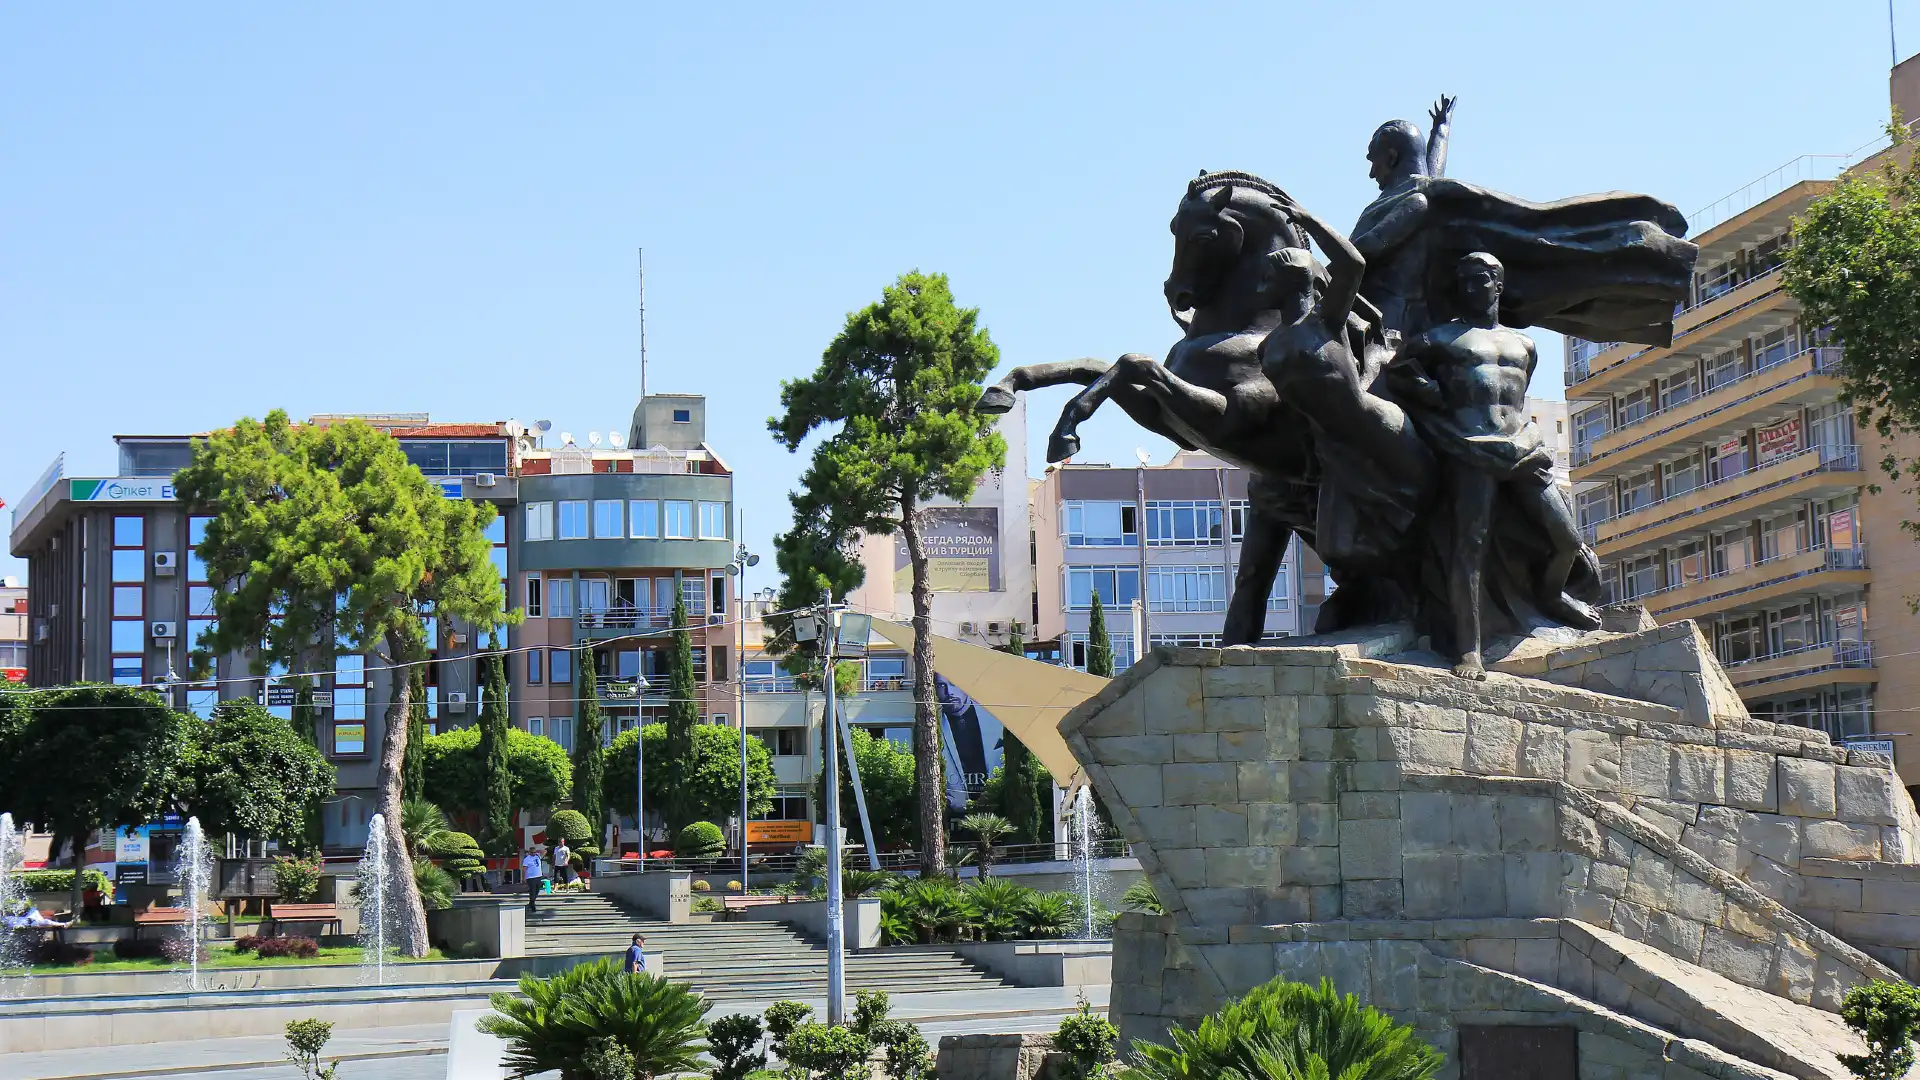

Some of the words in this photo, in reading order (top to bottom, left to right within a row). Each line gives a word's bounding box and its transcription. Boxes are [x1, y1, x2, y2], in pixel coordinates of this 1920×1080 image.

[919, 536, 954, 545] СЕГДА
[955, 536, 993, 545] РЯДОМ
[900, 547, 908, 556] С
[940, 547, 948, 555] В
[949, 547, 993, 557] ТУРЦИИ!
